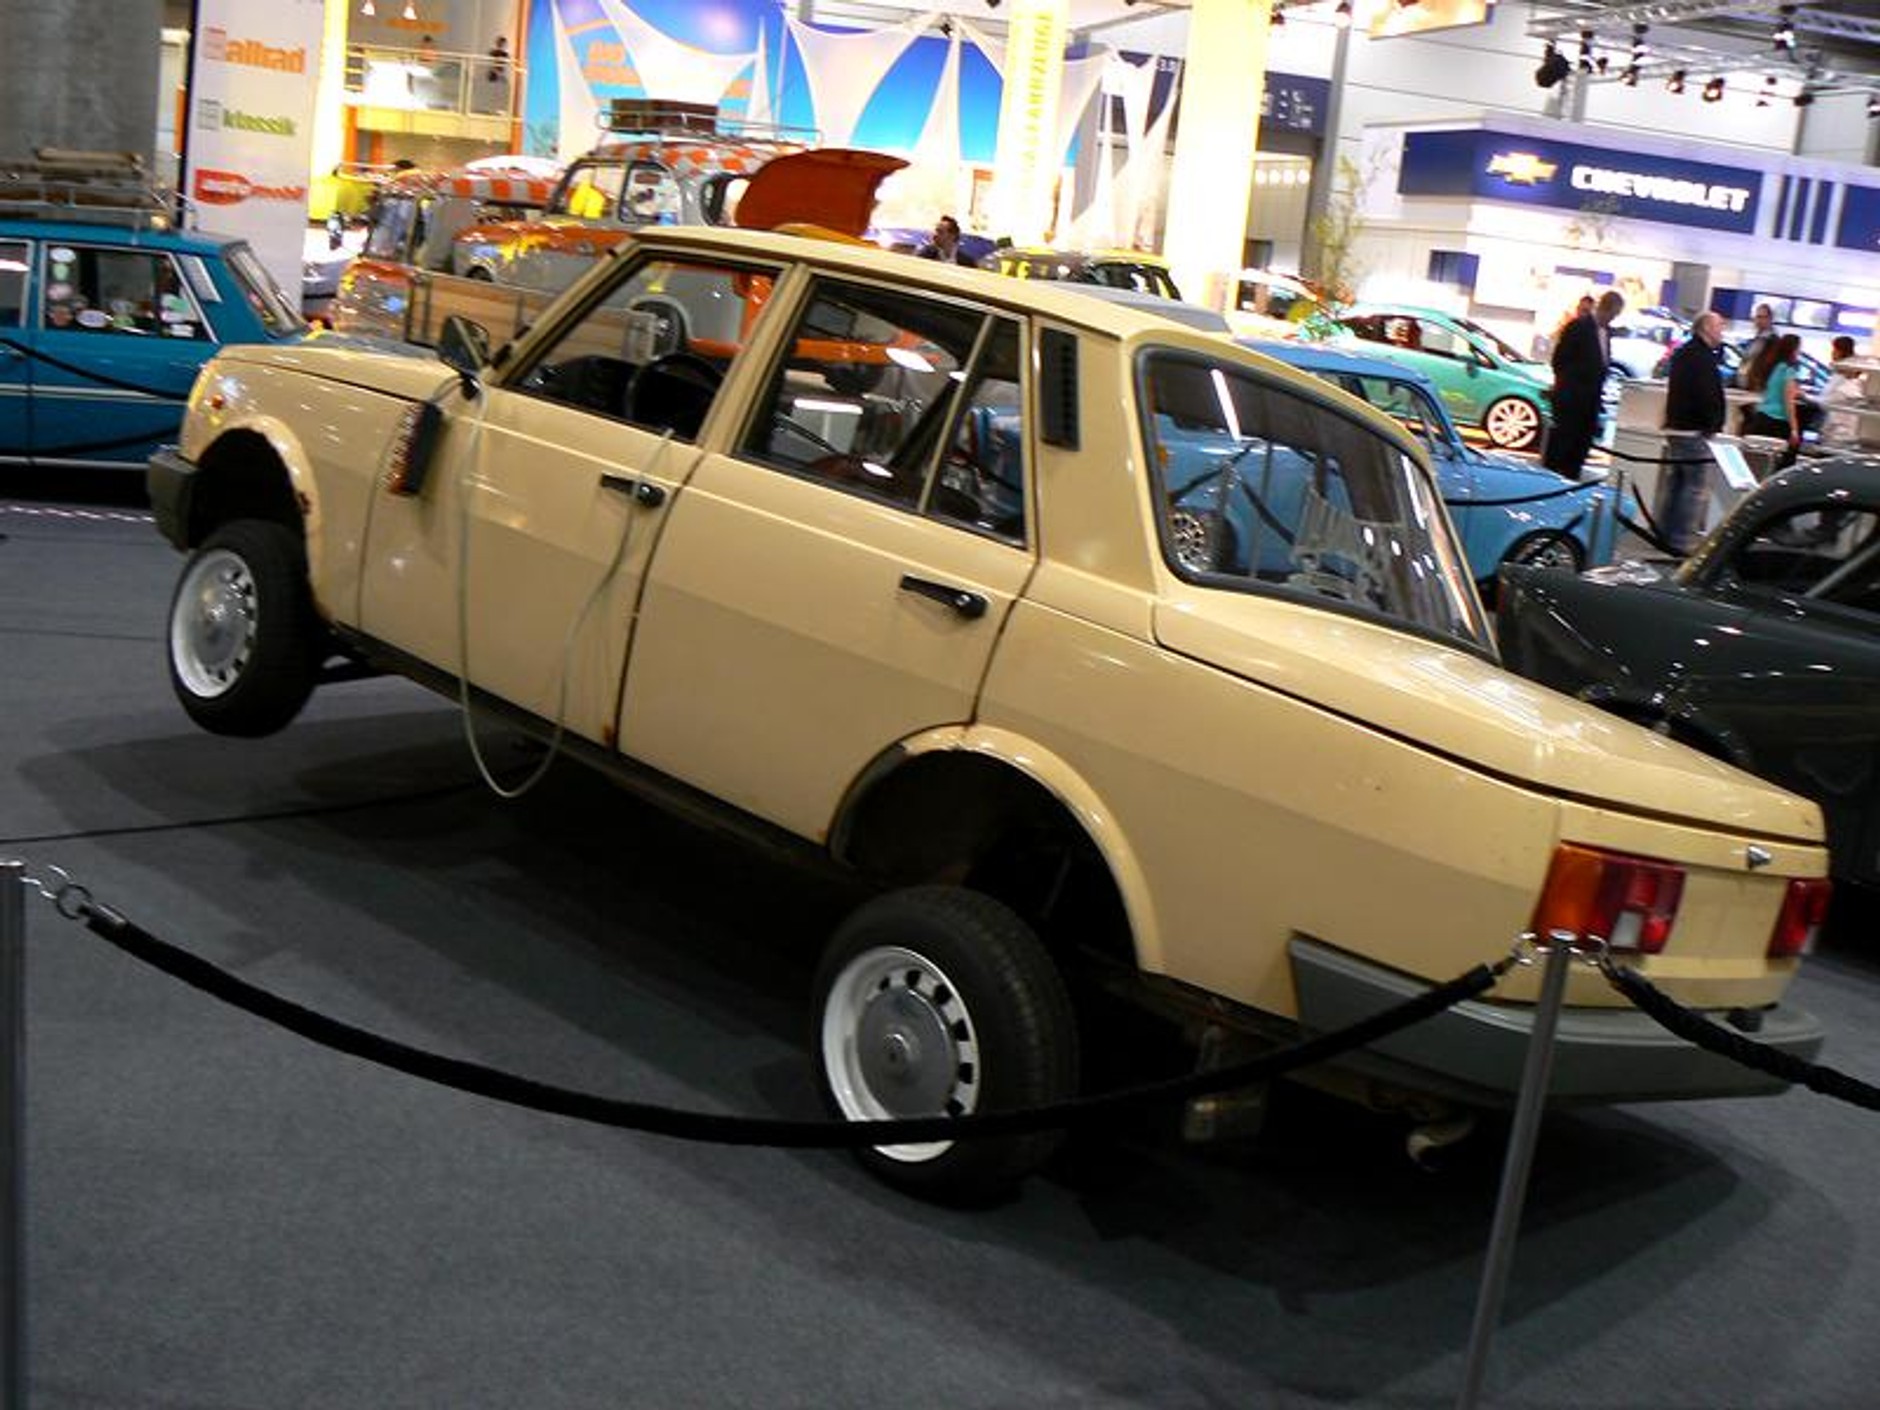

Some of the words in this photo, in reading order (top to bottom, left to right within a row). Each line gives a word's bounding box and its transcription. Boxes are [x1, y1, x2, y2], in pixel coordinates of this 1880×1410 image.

[226, 39, 304, 73] allrad
[223, 109, 295, 136] klassik
[1571, 165, 1749, 212] CHEVROLET
